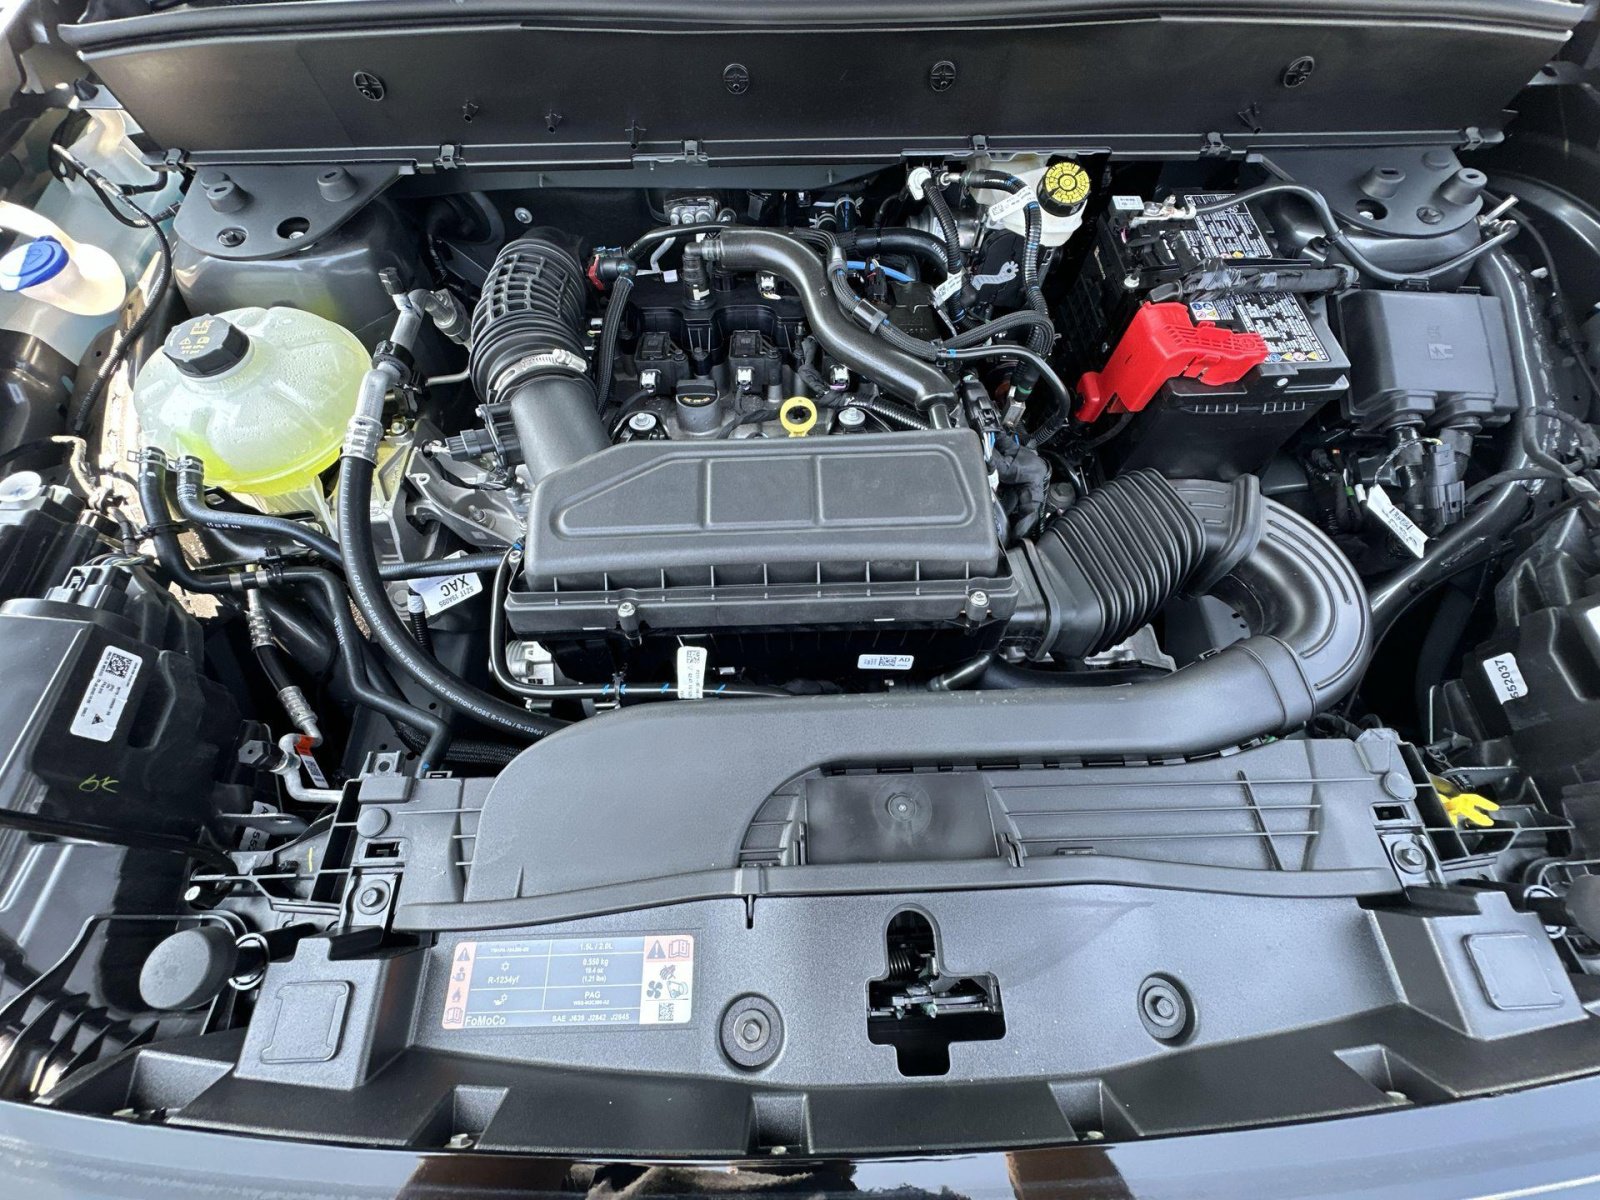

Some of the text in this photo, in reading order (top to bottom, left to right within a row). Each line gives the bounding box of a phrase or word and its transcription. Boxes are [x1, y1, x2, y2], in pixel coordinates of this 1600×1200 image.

[440, 574, 470, 597] XAC
[352, 573, 372, 608] GALAXY
[434, 683, 446, 693] A/C
[445, 690, 473, 709] SUCTION
[472, 704, 490, 717] HOSE
[490, 713, 512, 726] R-134a
[1495, 660, 1520, 698] 552037
[600, 958, 609, 967] kg
[487, 975, 520, 985] R-1234yf
[584, 991, 601, 999] PAG
[464, 1015, 506, 1026] FoMoCo
